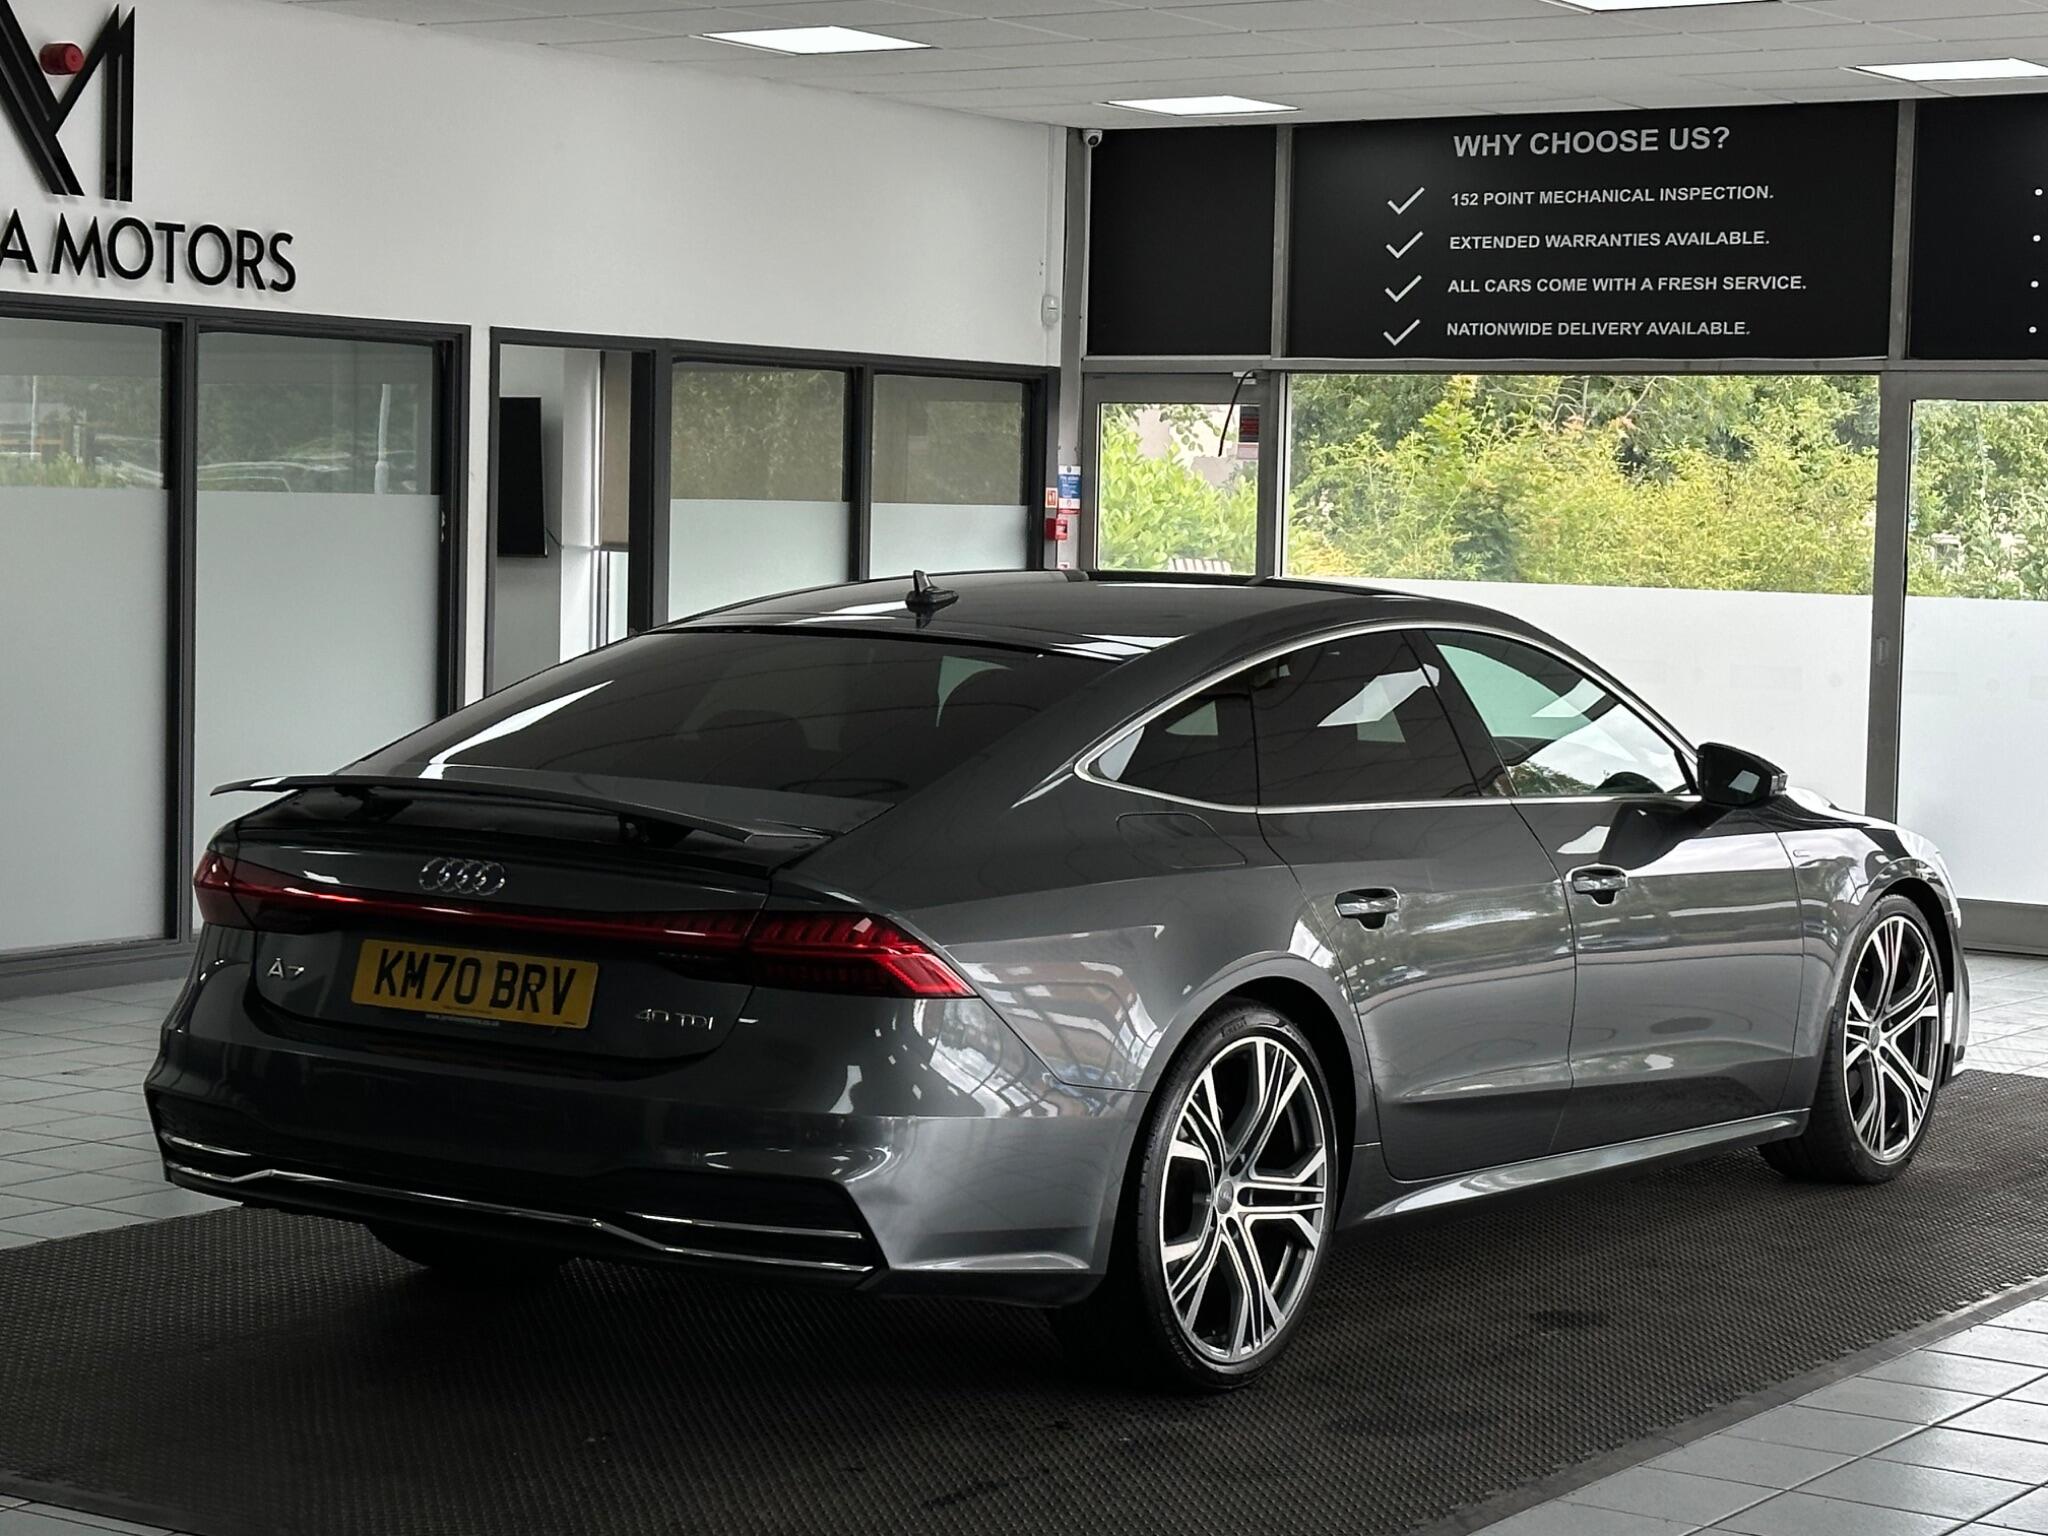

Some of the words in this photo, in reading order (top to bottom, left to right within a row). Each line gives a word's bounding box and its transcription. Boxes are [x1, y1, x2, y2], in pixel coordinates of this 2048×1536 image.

[1453, 133, 1522, 158] WHY
[1529, 129, 1659, 155] CHOOSE
[1669, 127, 1730, 151] US?
[1451, 192, 1479, 207] 152
[1483, 191, 1536, 206] POINT
[1539, 188, 1656, 205] MECHANICAL
[1659, 185, 1774, 202] INSPECTION.
[1449, 234, 1541, 250] EXTENDED
[1544, 232, 1661, 248] WARRANTIES
[1664, 230, 1770, 246] AVAILABLE.
[51, 212, 296, 293] MOTORS
[1447, 279, 1481, 293] ALL
[1484, 278, 1532, 293] CARS
[1536, 278, 1588, 292] COME
[1591, 277, 1637, 292] WITH
[1640, 277, 1654, 291] A
[1657, 276, 1718, 291] FRESH
[1722, 275, 1807, 291] SERVICE.
[1446, 321, 1553, 336] NATIONWIDE
[1557, 321, 1643, 336] DELIVERY
[1645, 321, 1751, 336] AVAILABLE.
[266, 957, 306, 979] A7
[372, 947, 482, 1005] KM70
[489, 960, 577, 1016] BRV
